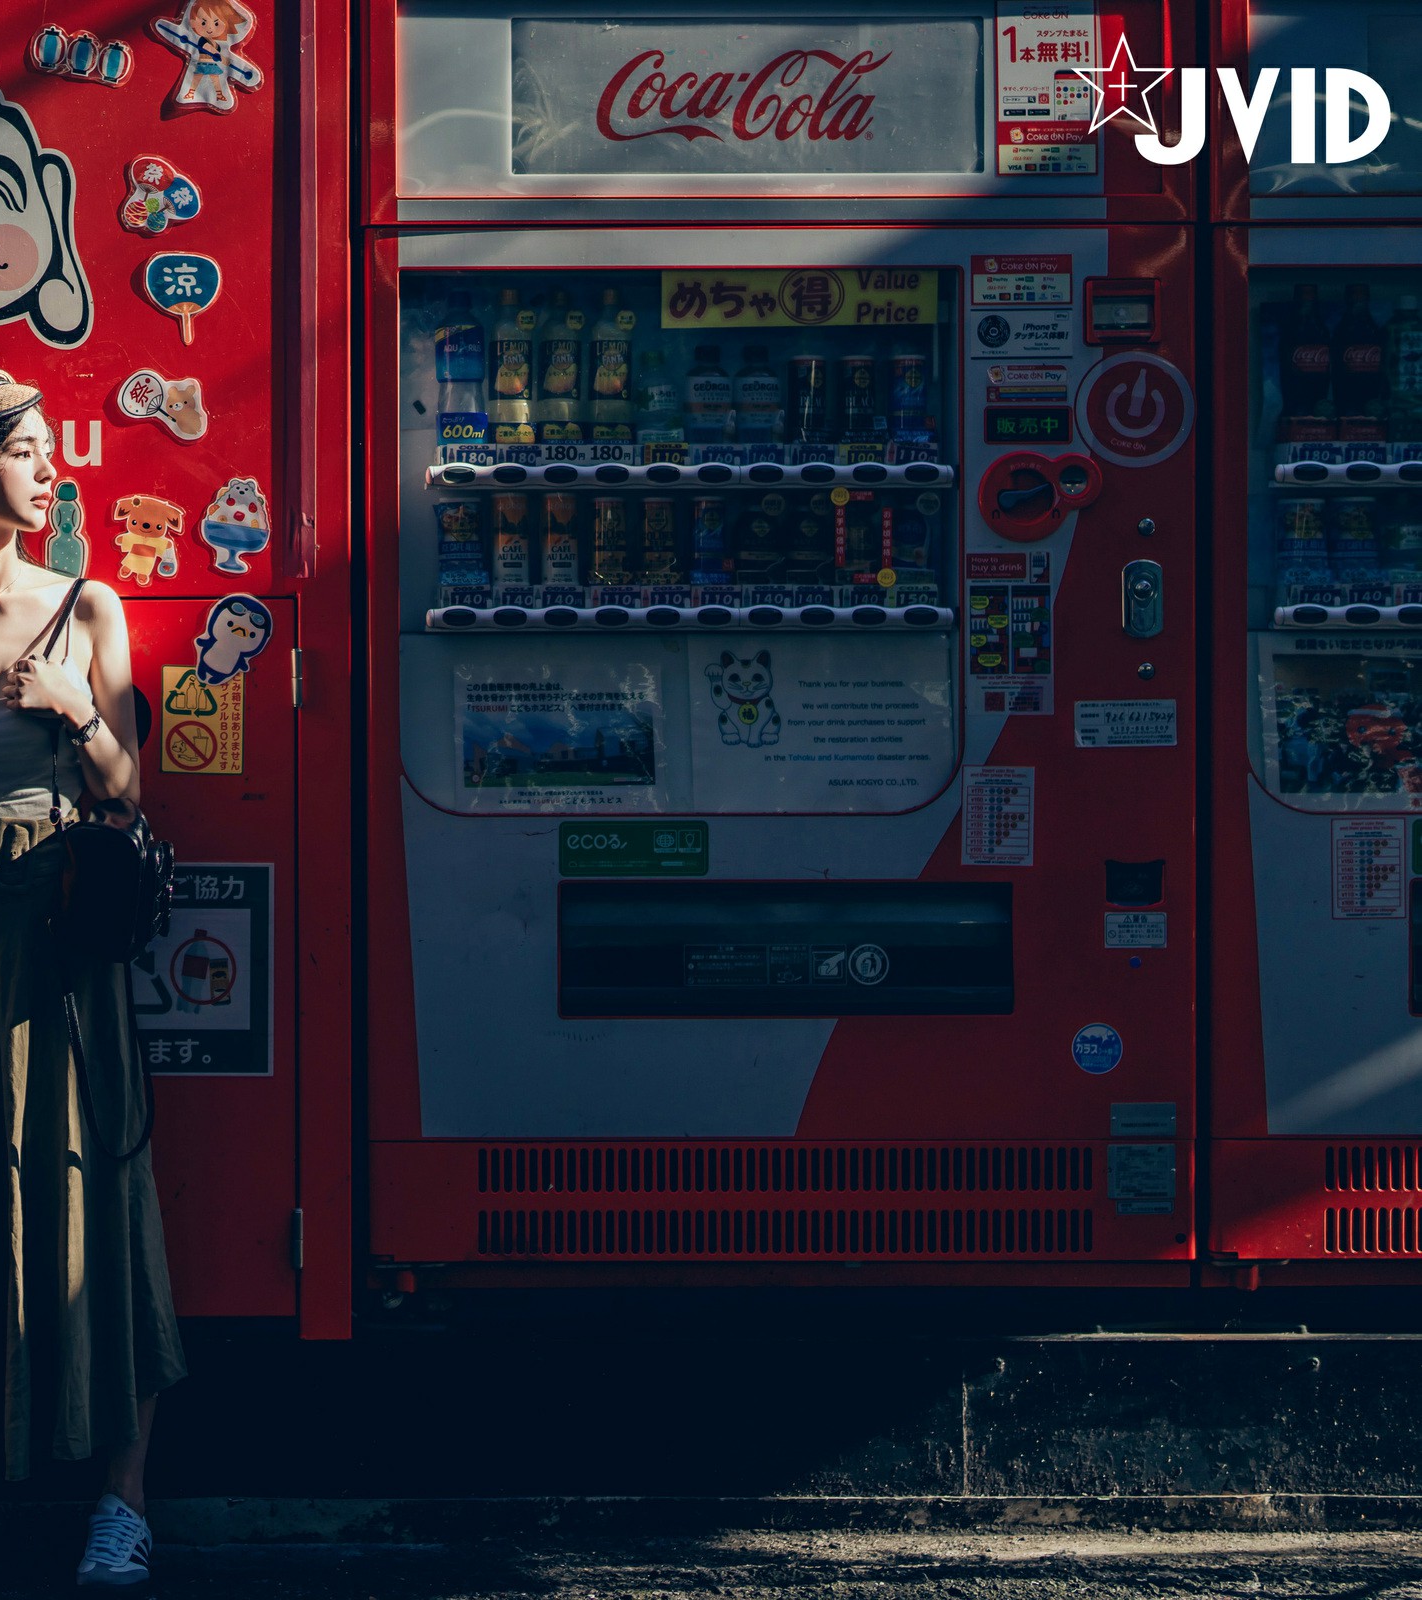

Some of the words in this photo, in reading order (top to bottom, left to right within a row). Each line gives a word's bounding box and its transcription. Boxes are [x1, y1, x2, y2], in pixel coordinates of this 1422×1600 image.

[1023, 11, 1050, 20] Coke
[597, 49, 892, 143] Coca-Cola
[1026, 133, 1049, 141] Coke
[1066, 133, 1083, 142] Pay
[1000, 262, 1023, 271] Coke
[1040, 262, 1058, 272] Pay
[163, 263, 203, 297] 涼
[856, 269, 920, 290] Value
[669, 281, 777, 320] めちゃ
[790, 276, 832, 318] 得
[856, 302, 918, 323] Price
[1006, 372, 1029, 380] Coke
[1044, 372, 1062, 382] Pay
[130, 381, 153, 407] 祭
[442, 424, 484, 439] 600ml
[996, 416, 1058, 435] 販売中
[1110, 438, 1132, 449] Coke
[545, 446, 585, 461] 180円
[591, 446, 631, 461] 180円
[970, 564, 988, 572] buy
[998, 563, 1023, 571] drink
[885, 702, 919, 711] proceeds
[219, 682, 229, 771] サイクルBOXです
[847, 719, 885, 727] purchases
[897, 718, 925, 727] support
